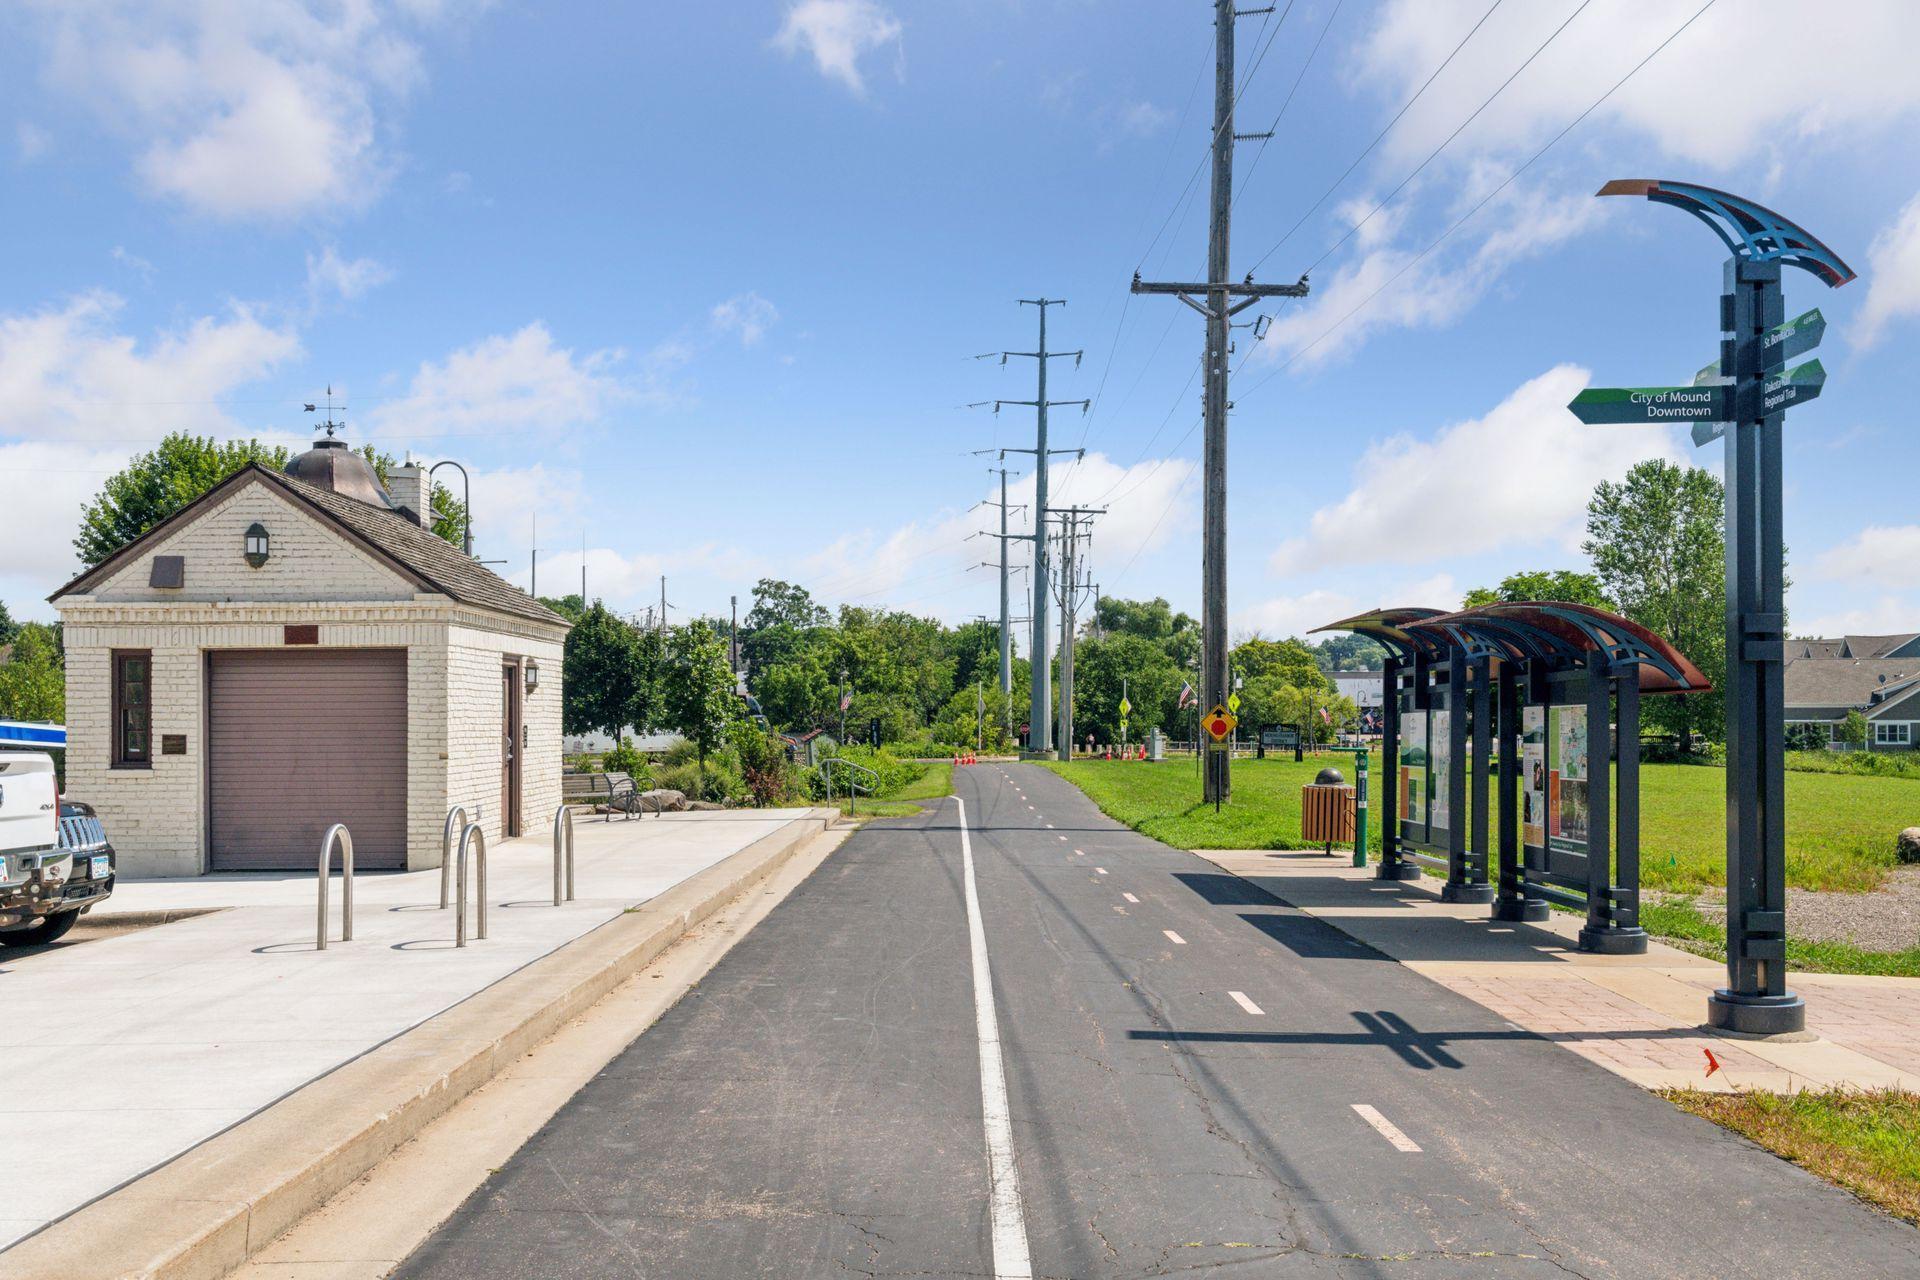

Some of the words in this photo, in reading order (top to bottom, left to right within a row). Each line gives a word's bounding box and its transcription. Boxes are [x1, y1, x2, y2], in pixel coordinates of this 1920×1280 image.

[1765, 380, 1781, 394] Dakota
[1630, 392, 1653, 405] City
[1655, 391, 1667, 403] of
[1670, 391, 1711, 402] Mound
[1764, 390, 1785, 409] Regional
[1785, 386, 1796, 400] Trail
[1647, 406, 1711, 417] Downtown
